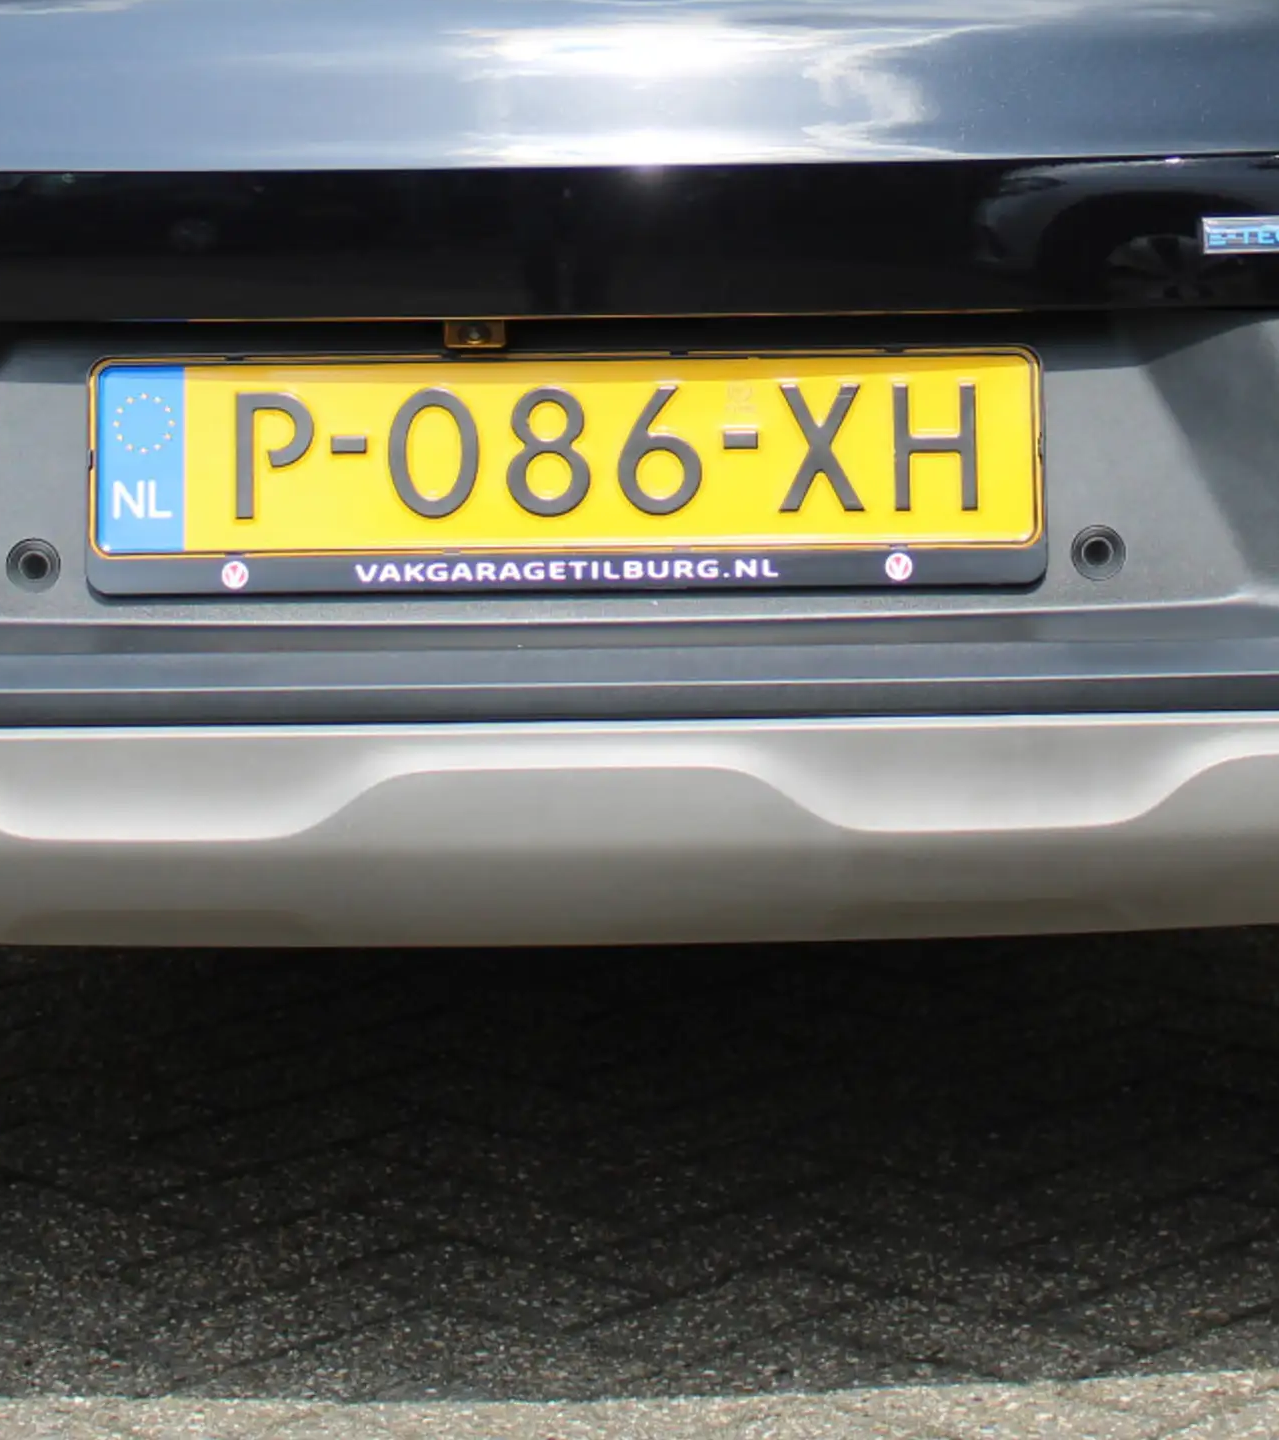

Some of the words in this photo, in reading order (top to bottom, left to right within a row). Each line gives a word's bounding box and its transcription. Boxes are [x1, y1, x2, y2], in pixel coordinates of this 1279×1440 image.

[233, 382, 978, 521] P-086-XH
[112, 480, 172, 521] NL
[354, 558, 779, 584] VAKGARAGETILBURG.NL
